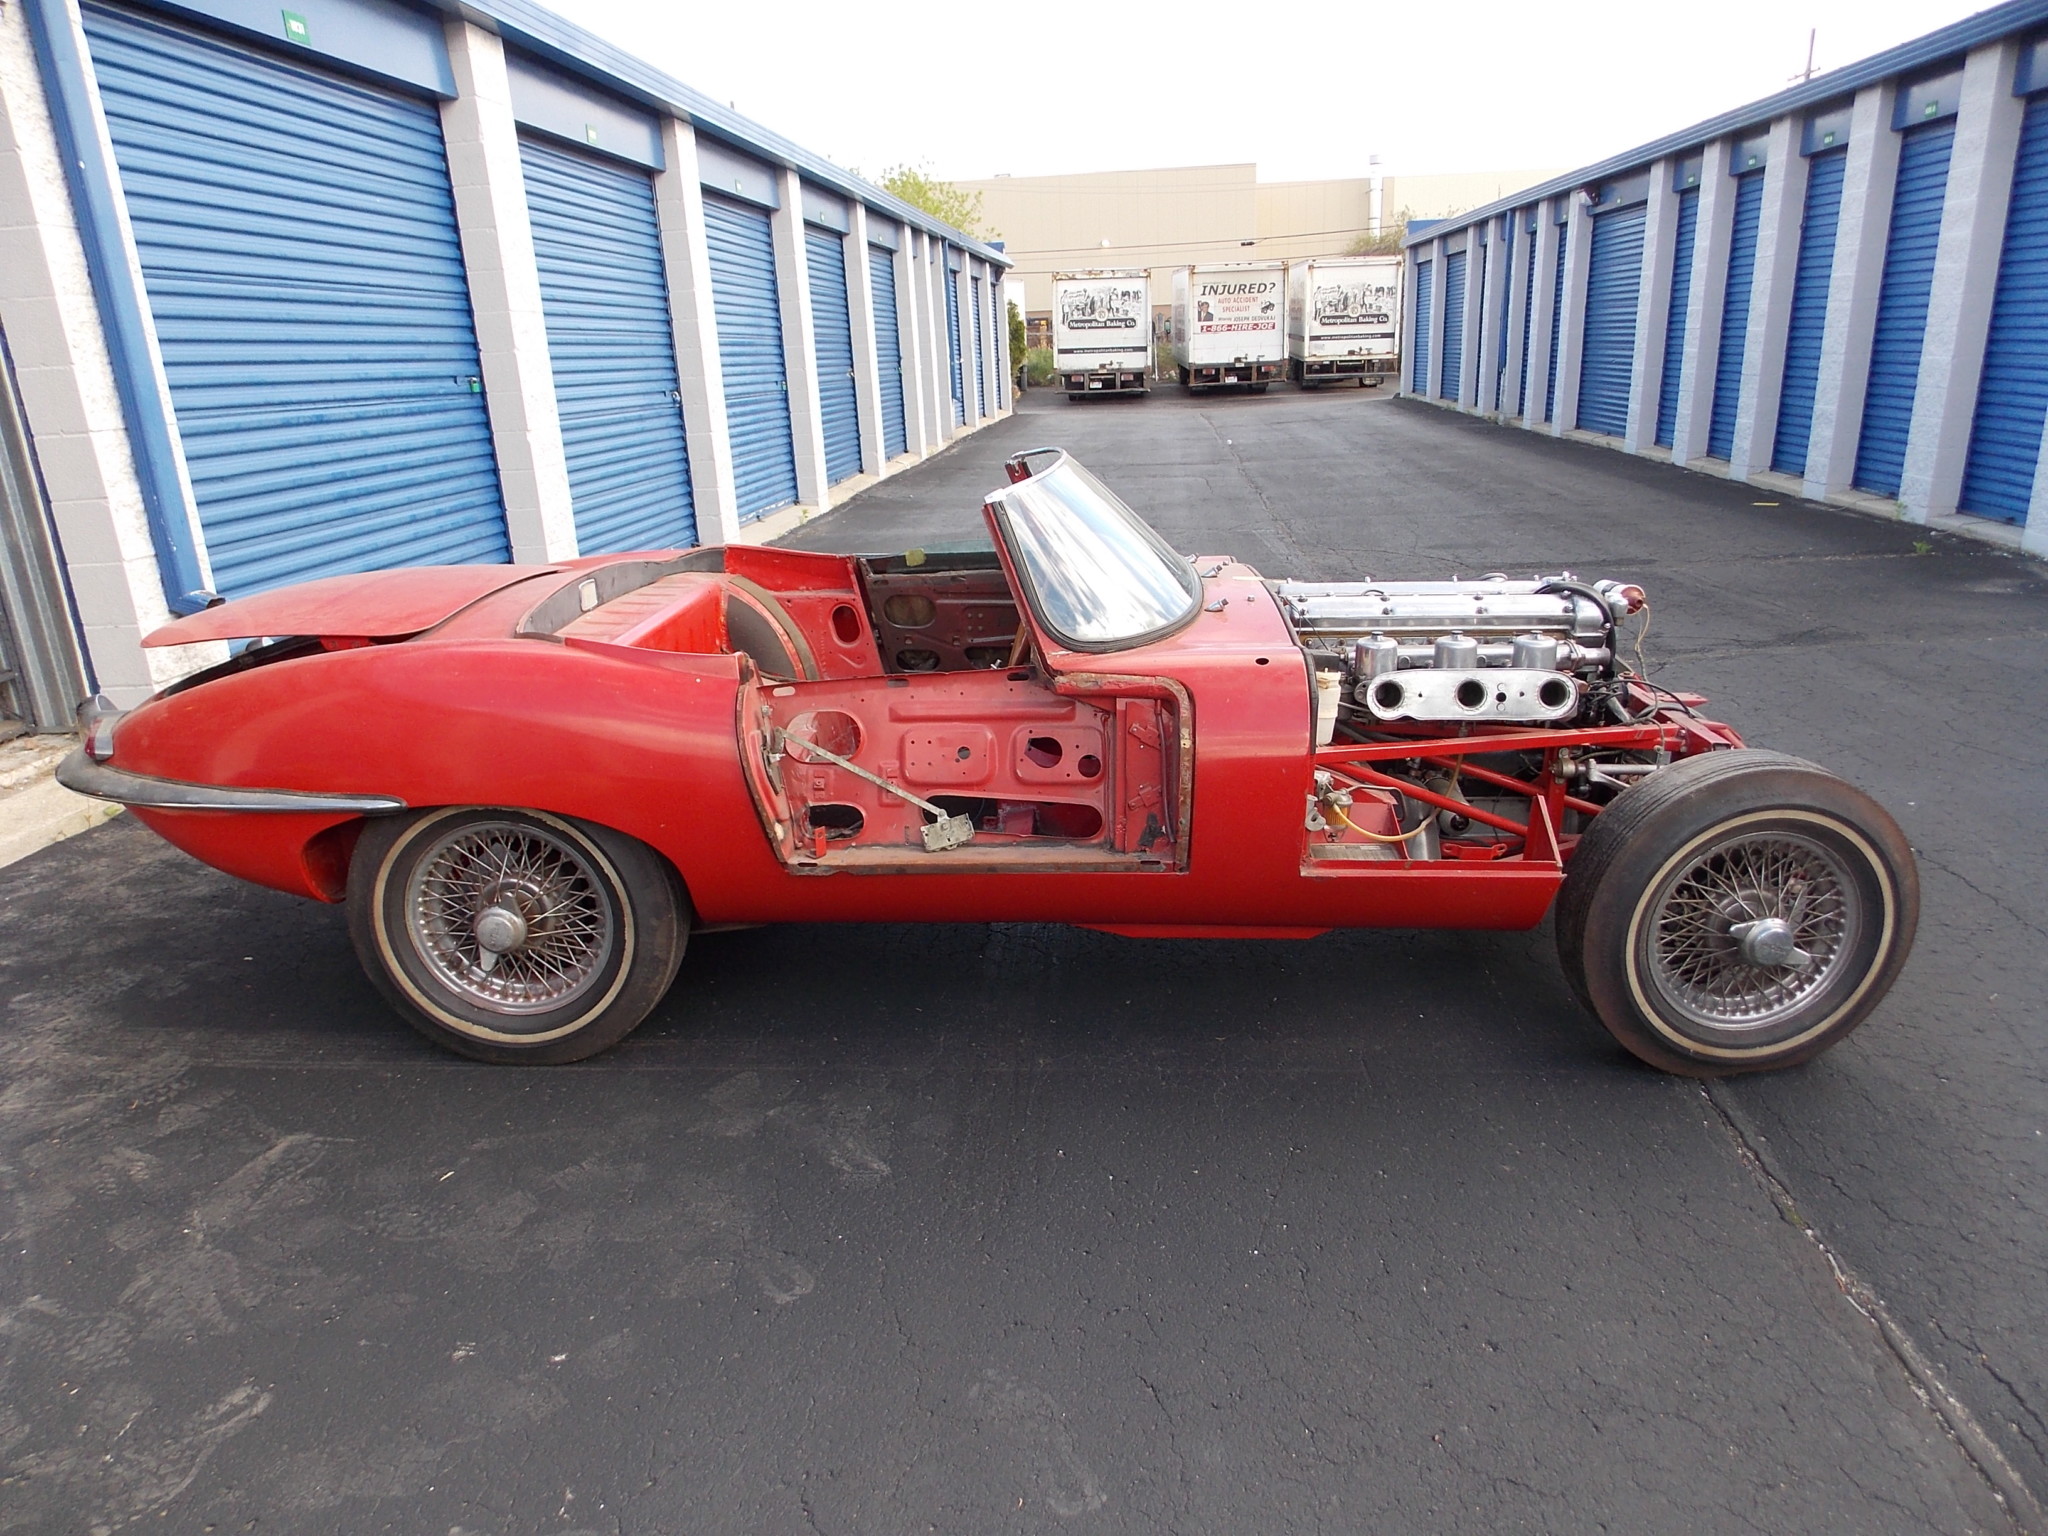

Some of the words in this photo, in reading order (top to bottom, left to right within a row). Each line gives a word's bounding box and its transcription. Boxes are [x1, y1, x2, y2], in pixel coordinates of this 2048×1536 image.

[1201, 282, 1276, 296] INJURED?
[1069, 321, 1105, 330] Metropolitan
[1106, 320, 1125, 329] Baking
[1321, 317, 1357, 326] Metropolitan
[1358, 316, 1378, 324] Baking
[1202, 322, 1274, 333] 1-866-HIRE-JOE
